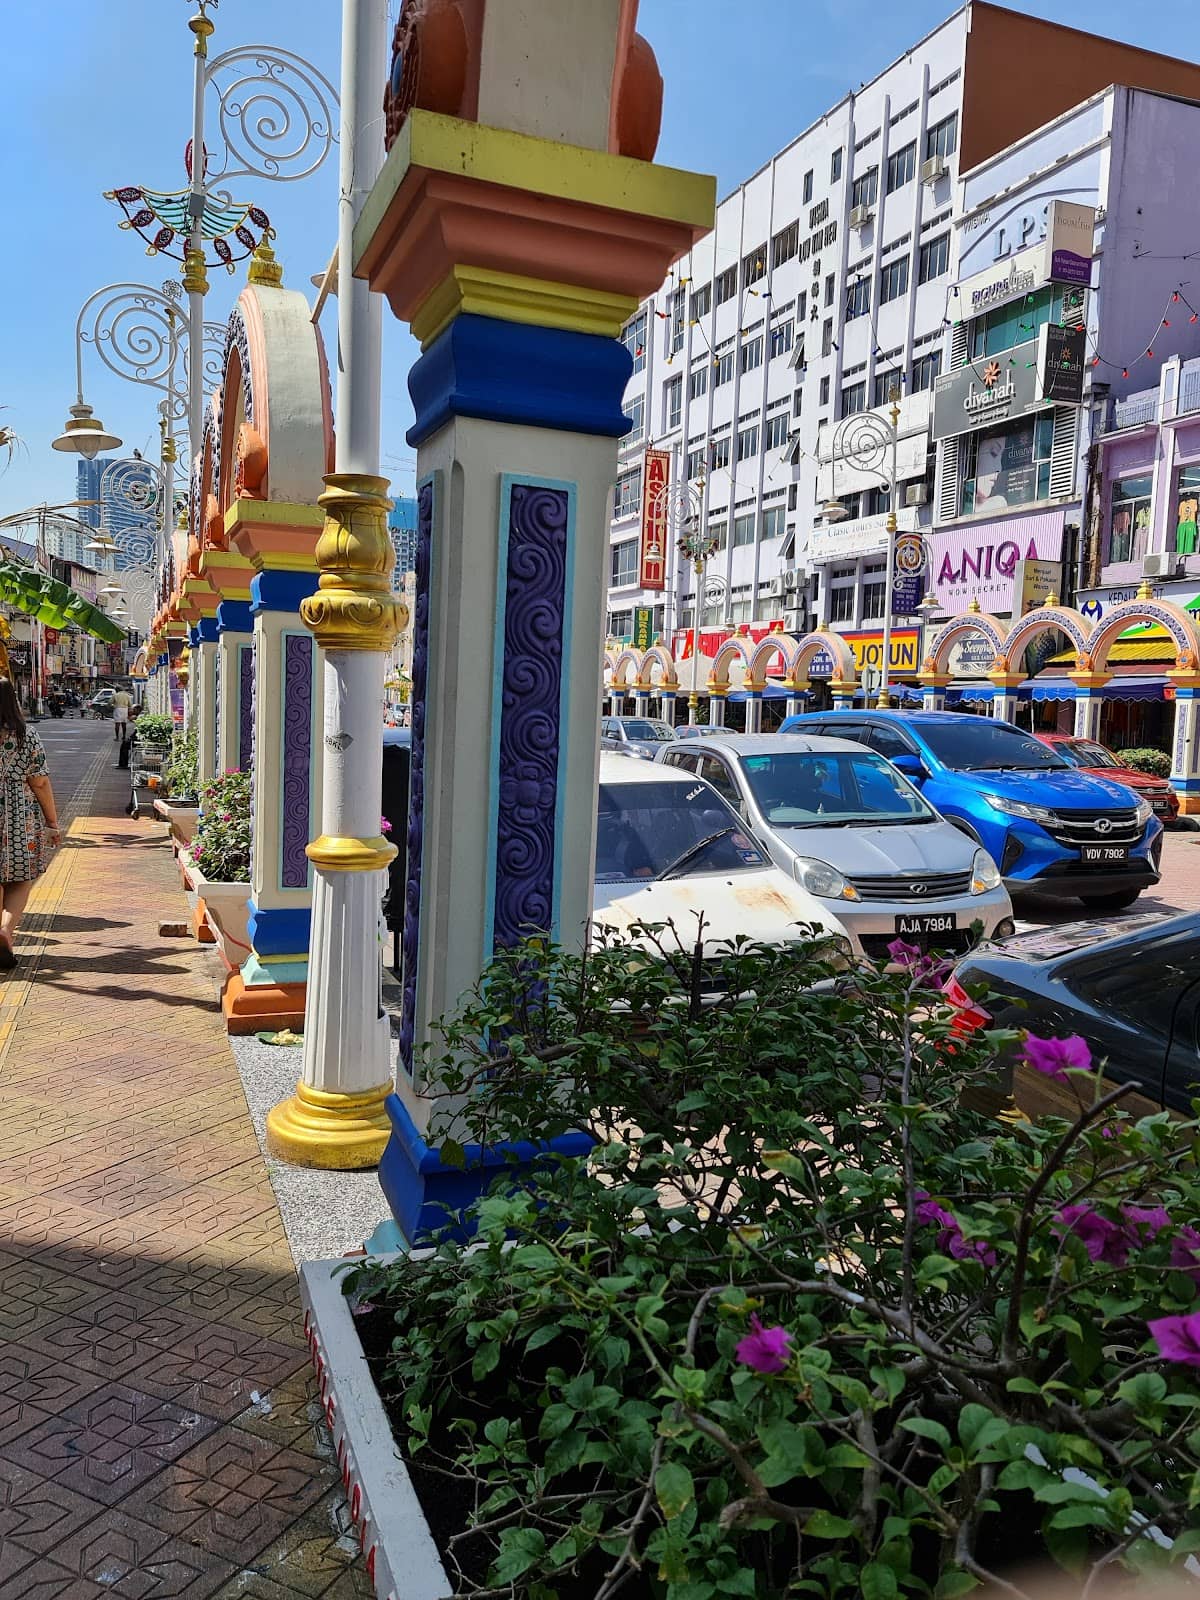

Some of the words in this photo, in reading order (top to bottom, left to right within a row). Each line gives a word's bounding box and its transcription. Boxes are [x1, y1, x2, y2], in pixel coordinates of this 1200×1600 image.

[963, 211, 991, 234] WISMA
[963, 369, 1016, 410] divanah
[971, 583, 1008, 596] SECRET
[1086, 848, 1101, 860] VDV
[1104, 848, 1125, 860] 7902
[900, 918, 921, 933] AJA
[923, 916, 953, 932] 7984
